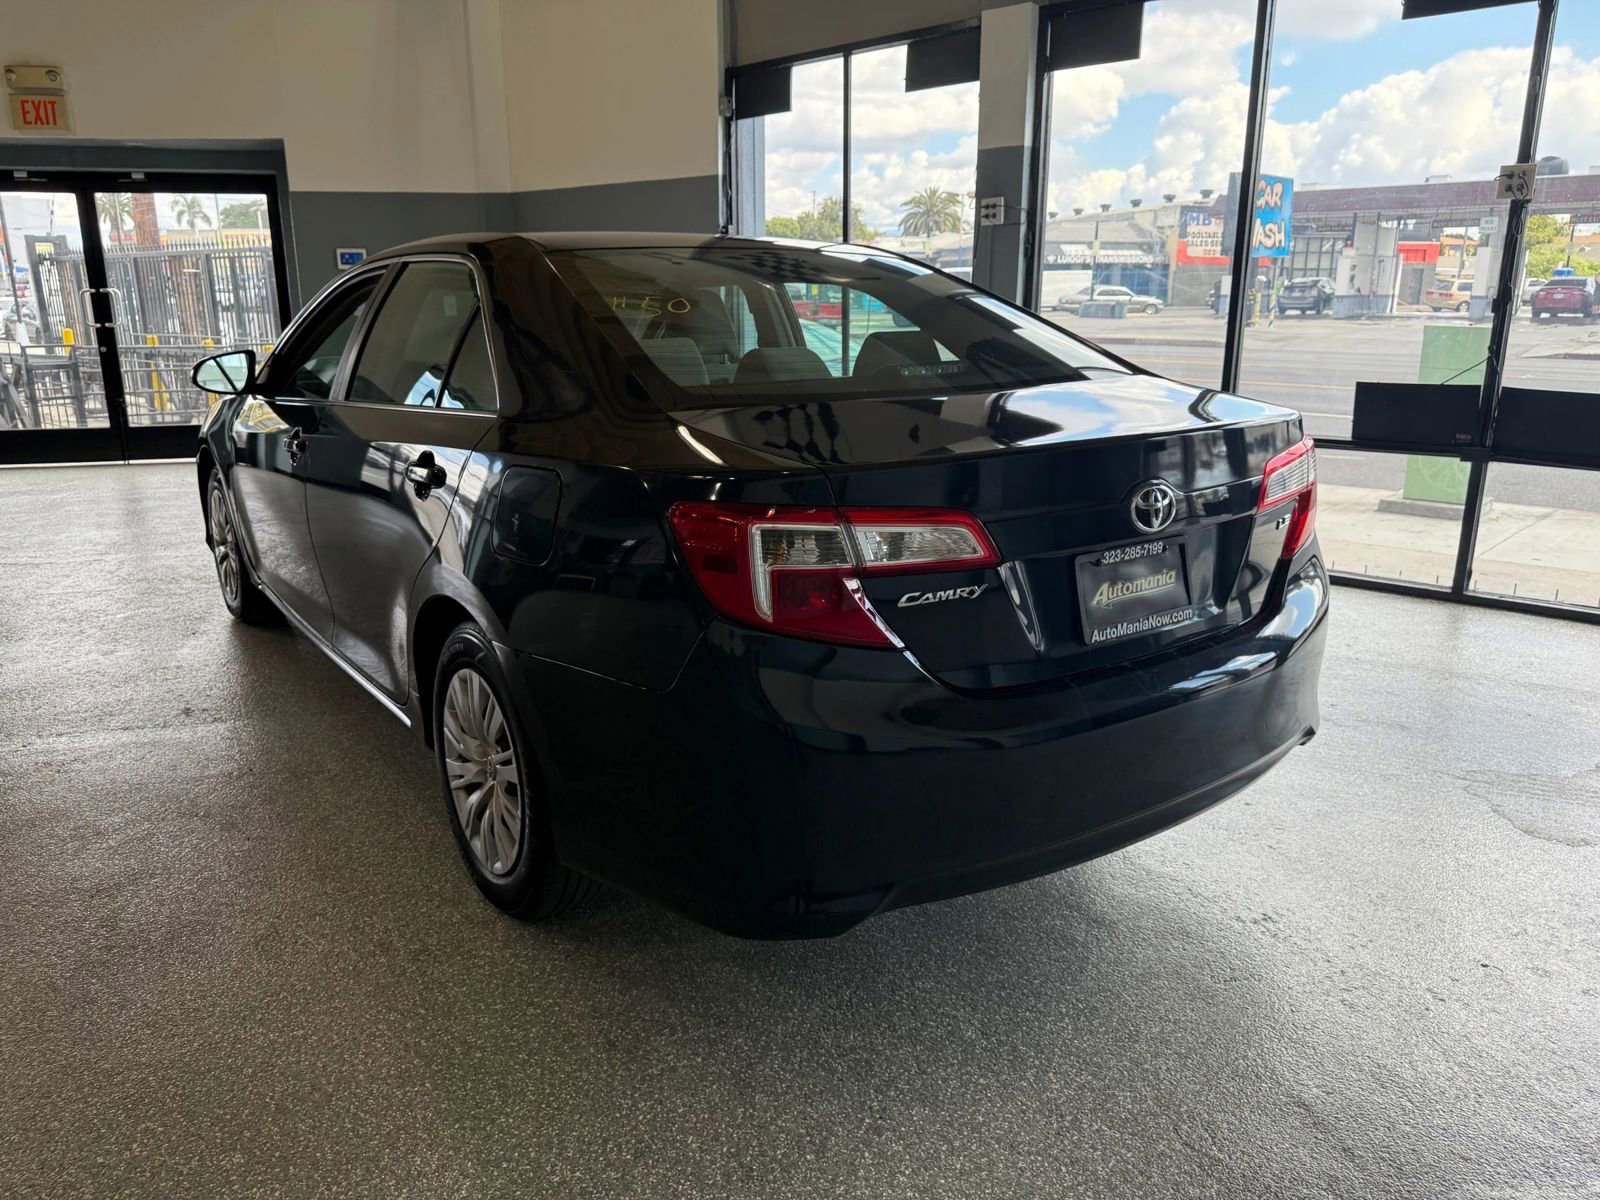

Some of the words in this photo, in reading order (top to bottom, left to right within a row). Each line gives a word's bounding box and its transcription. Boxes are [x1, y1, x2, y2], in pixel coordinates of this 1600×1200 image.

[20, 99, 58, 126] EXIT
[1102, 541, 1164, 565] 323-285-7199
[897, 583, 989, 608] CAMRY
[1090, 568, 1177, 607] Automania
[1091, 608, 1193, 643] AutoManiaNow.com
